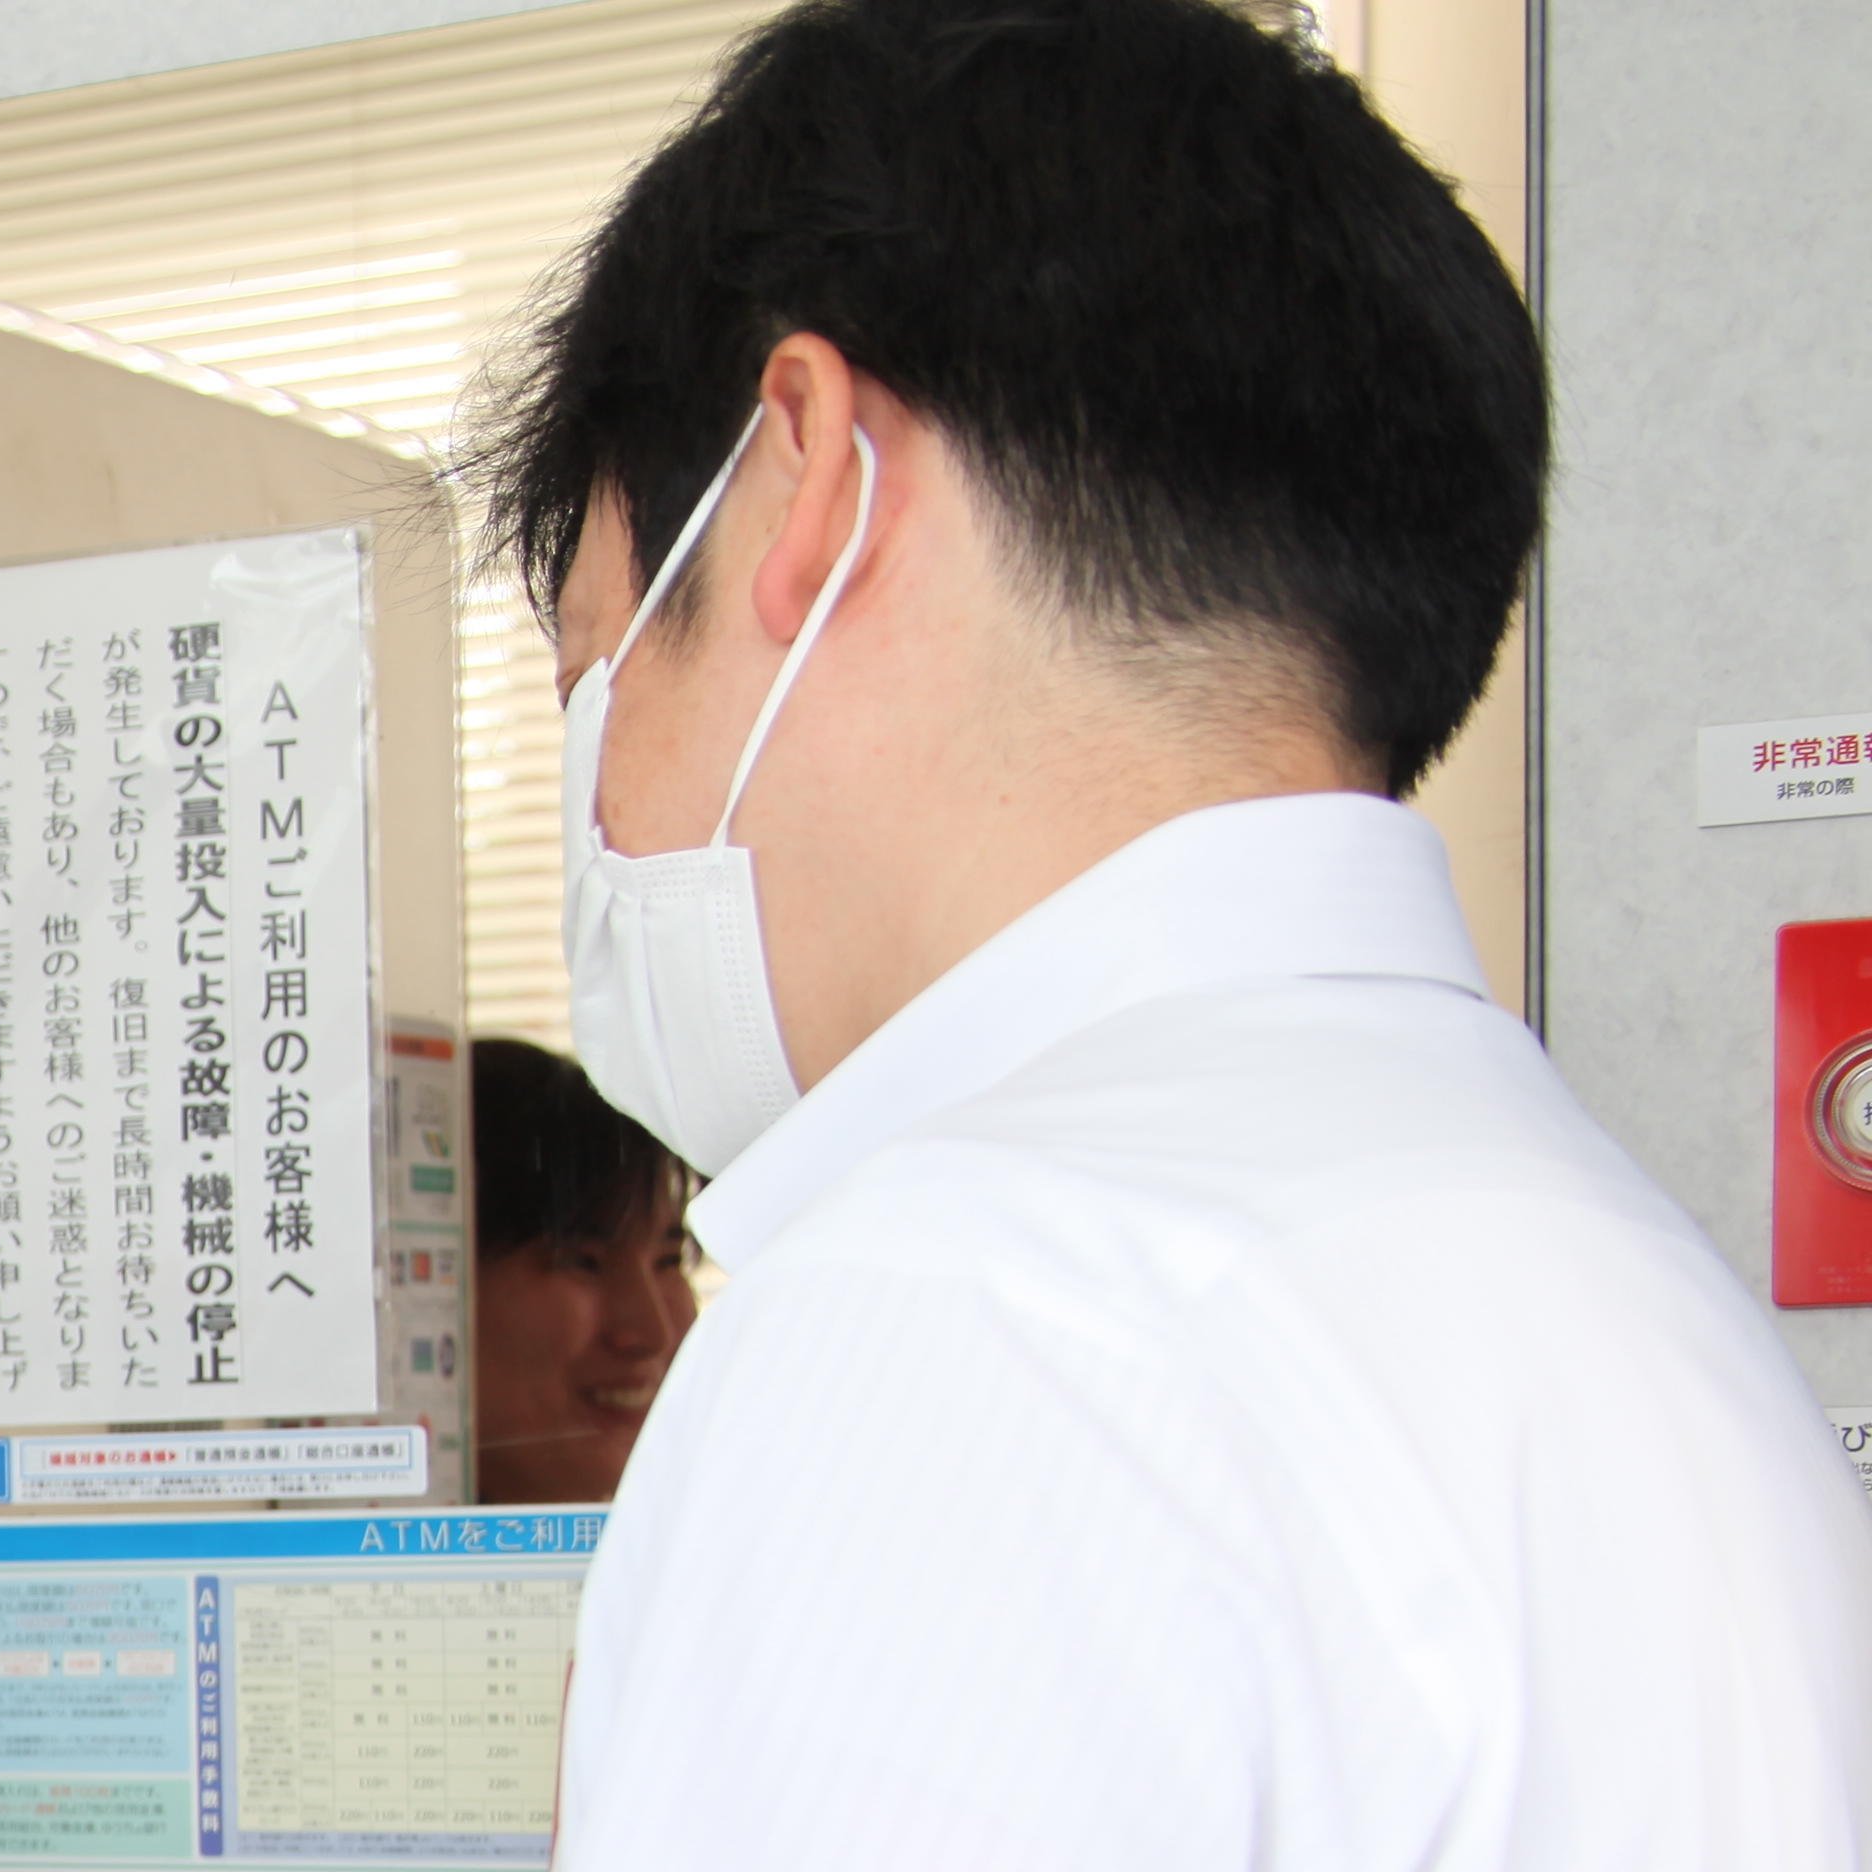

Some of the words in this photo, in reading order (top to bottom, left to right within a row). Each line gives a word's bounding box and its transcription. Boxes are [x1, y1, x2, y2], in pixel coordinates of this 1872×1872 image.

[36, 636, 93, 1393] だく場合もあり、他のお客様へのご迷惑となりま
[103, 627, 160, 1391] が発生しております。復旧まで長時間お待ちいた
[167, 620, 241, 1387] 硬貨の大量投入による故障・機械の停止
[259, 680, 316, 1301] ATMご利用のお客様へ
[1751, 732, 1872, 773] 非常通
[1776, 776, 1856, 801] 非常の際
[360, 1516, 604, 1554] ATMをご利用
